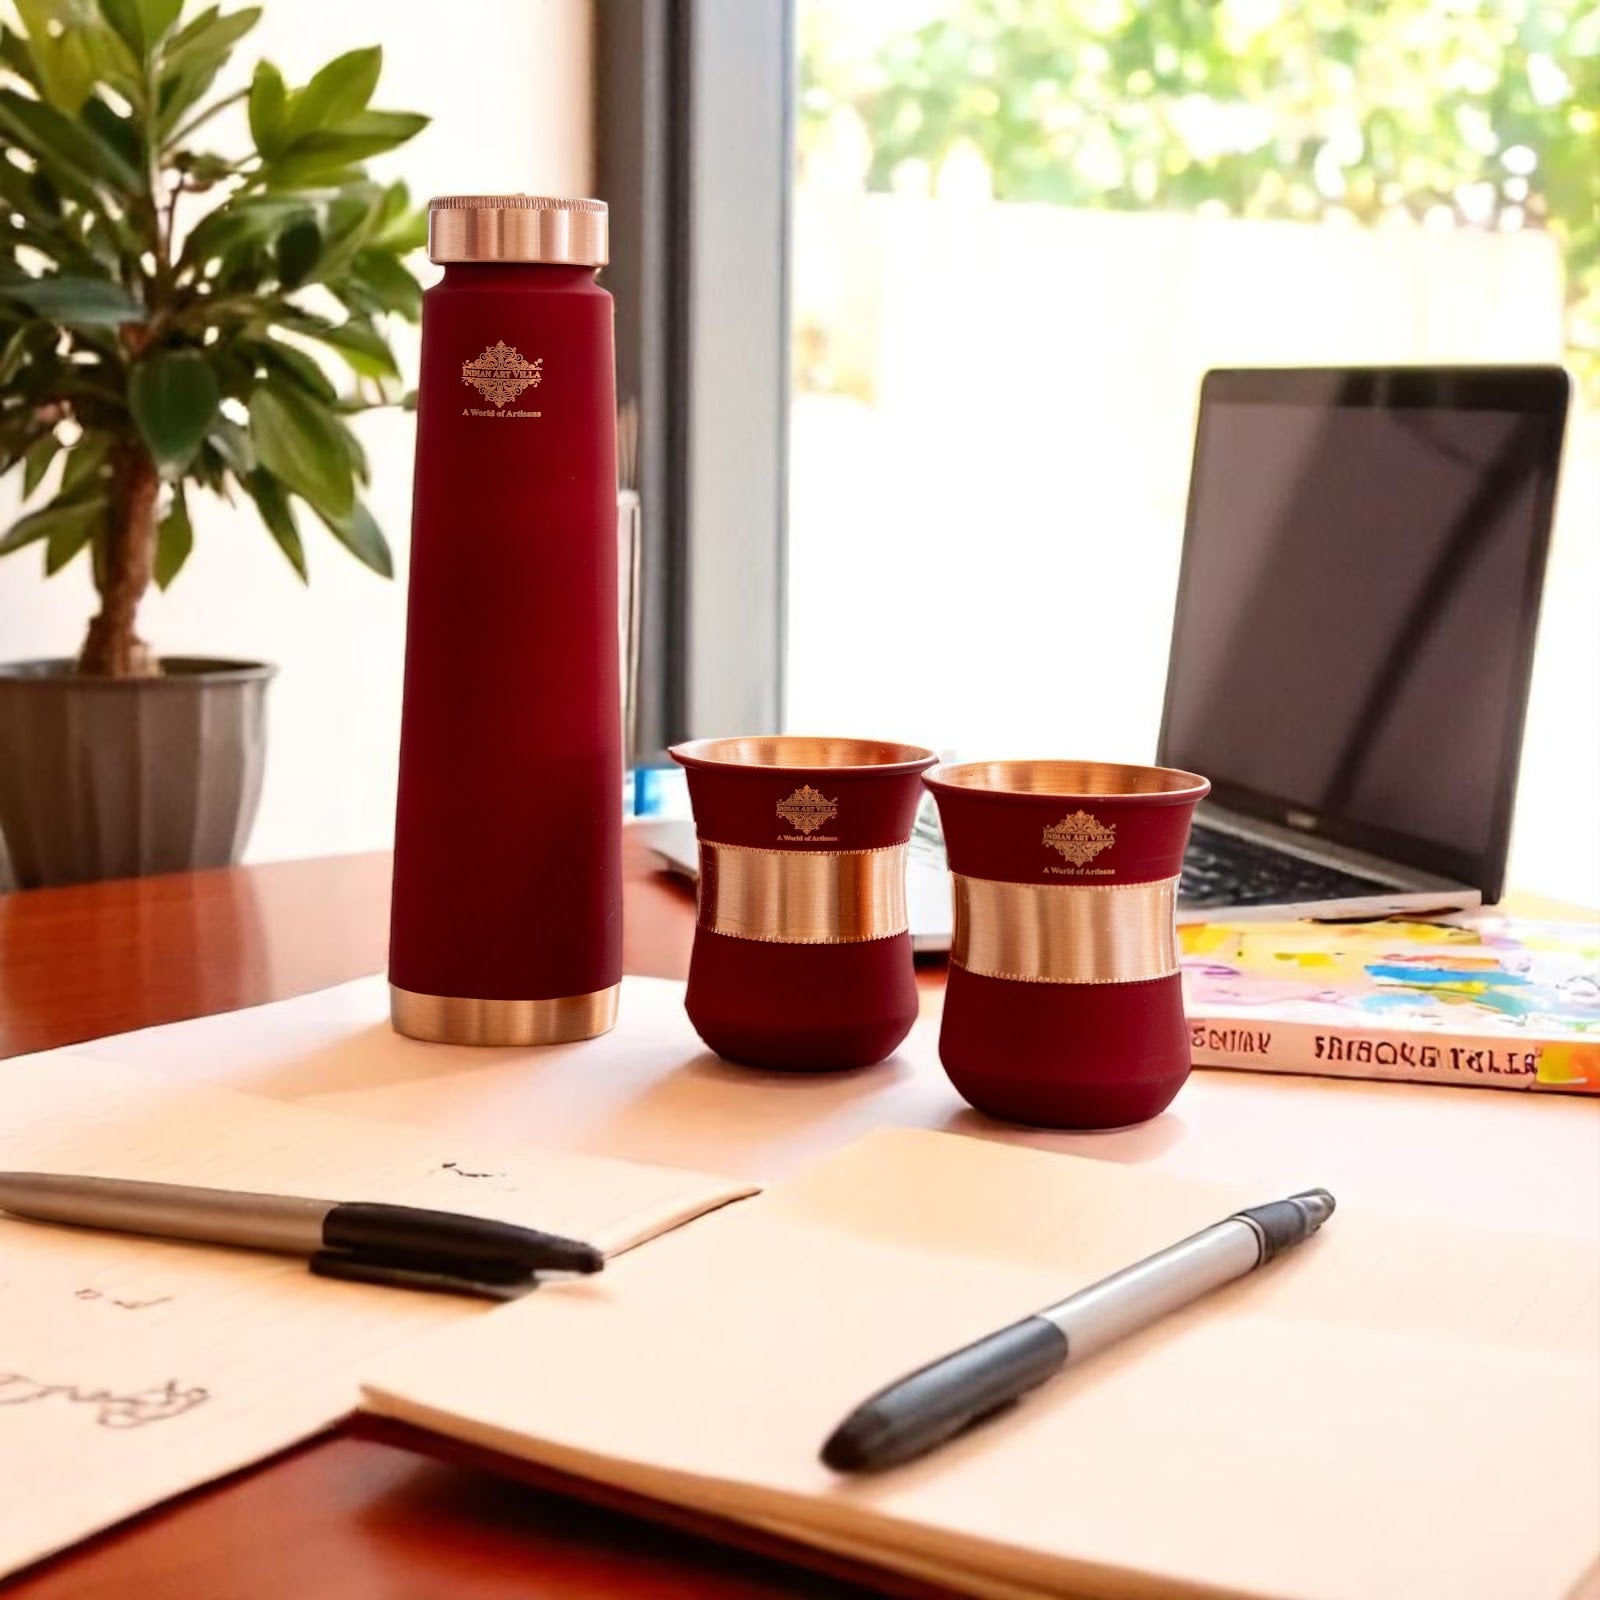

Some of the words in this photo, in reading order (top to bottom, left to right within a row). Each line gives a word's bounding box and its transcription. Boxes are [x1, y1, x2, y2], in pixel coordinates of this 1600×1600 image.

[463, 368, 491, 377] INDIAN
[493, 370, 511, 378] ART
[512, 370, 541, 379] VILLA
[470, 409, 495, 417] World
[496, 410, 506, 418] of
[506, 410, 542, 418] Artisans
[1043, 831, 1071, 840] INDIAN
[1072, 833, 1089, 841] ART
[1089, 833, 1115, 841] VILLA
[1050, 867, 1075, 875] World
